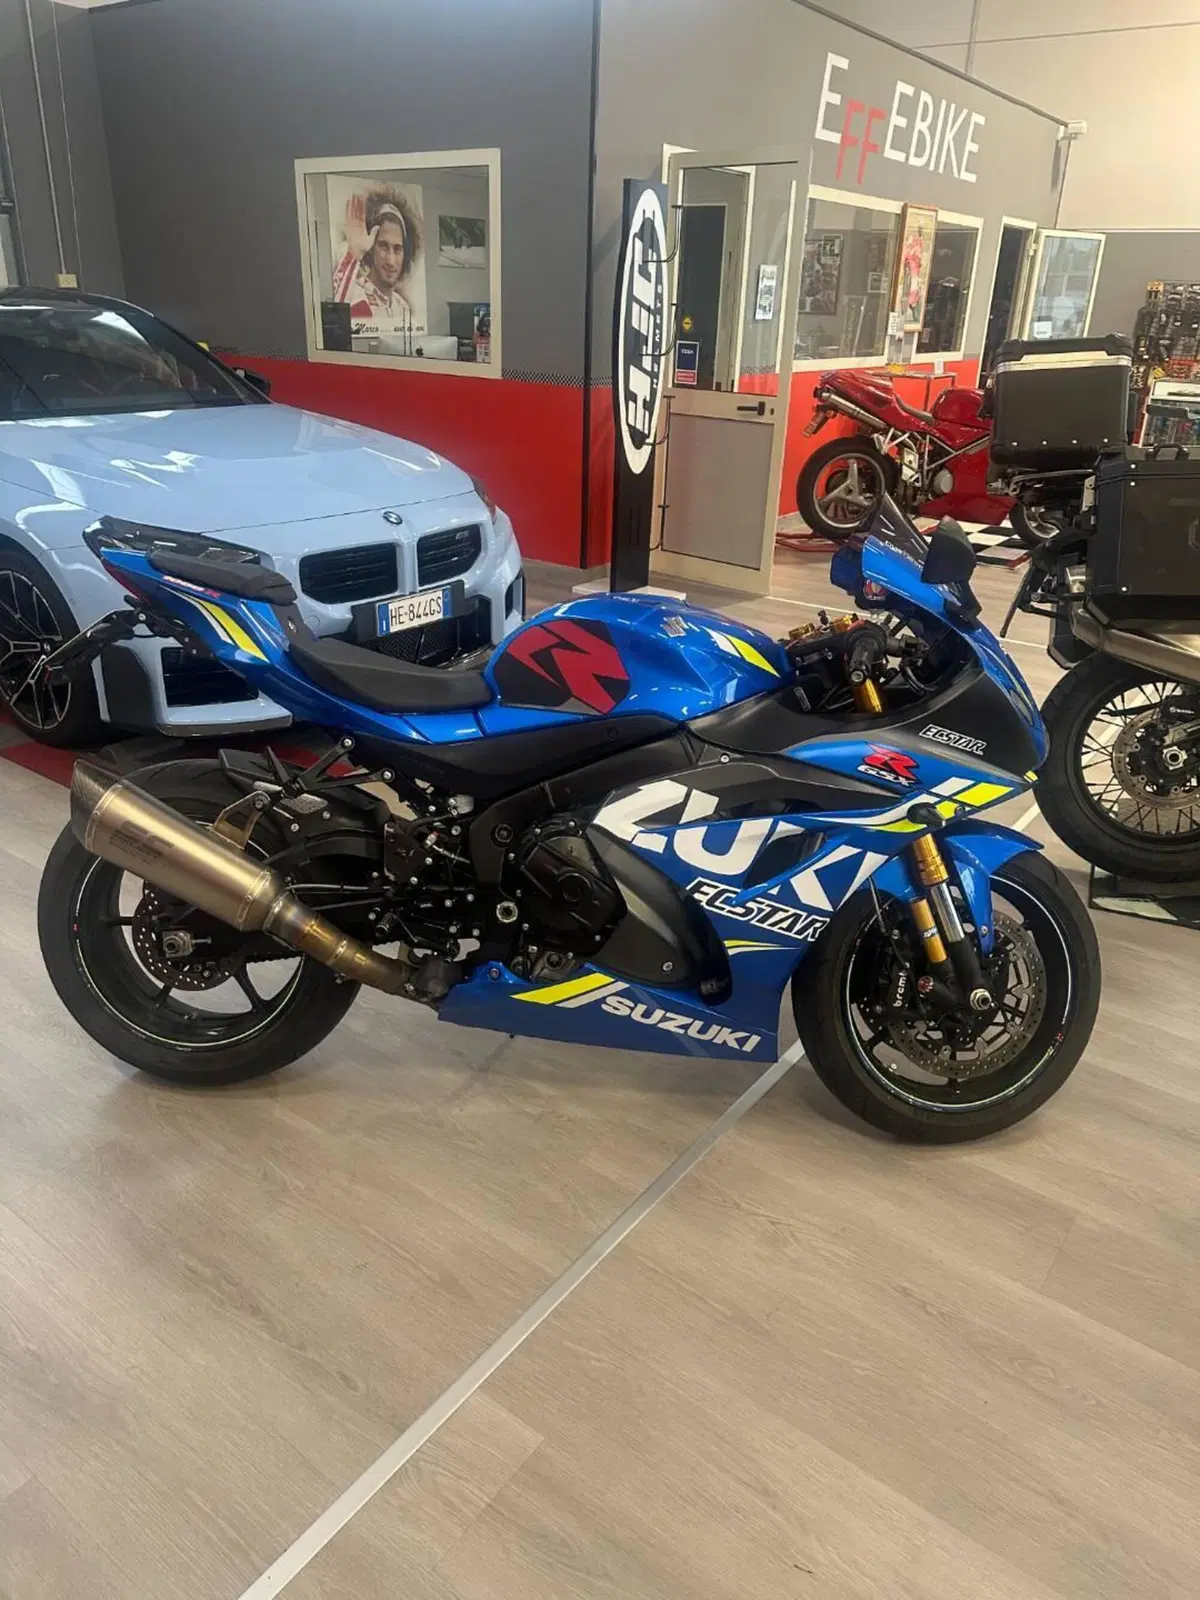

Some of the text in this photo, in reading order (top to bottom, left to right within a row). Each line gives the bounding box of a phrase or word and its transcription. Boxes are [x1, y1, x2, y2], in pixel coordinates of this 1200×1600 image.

[627, 236, 657, 438] HJC
[652, 284, 664, 389] HELMETS
[919, 724, 987, 756] ECSTAR
[685, 876, 831, 942] ECSTAR
[601, 995, 762, 1053] SUZUKI
